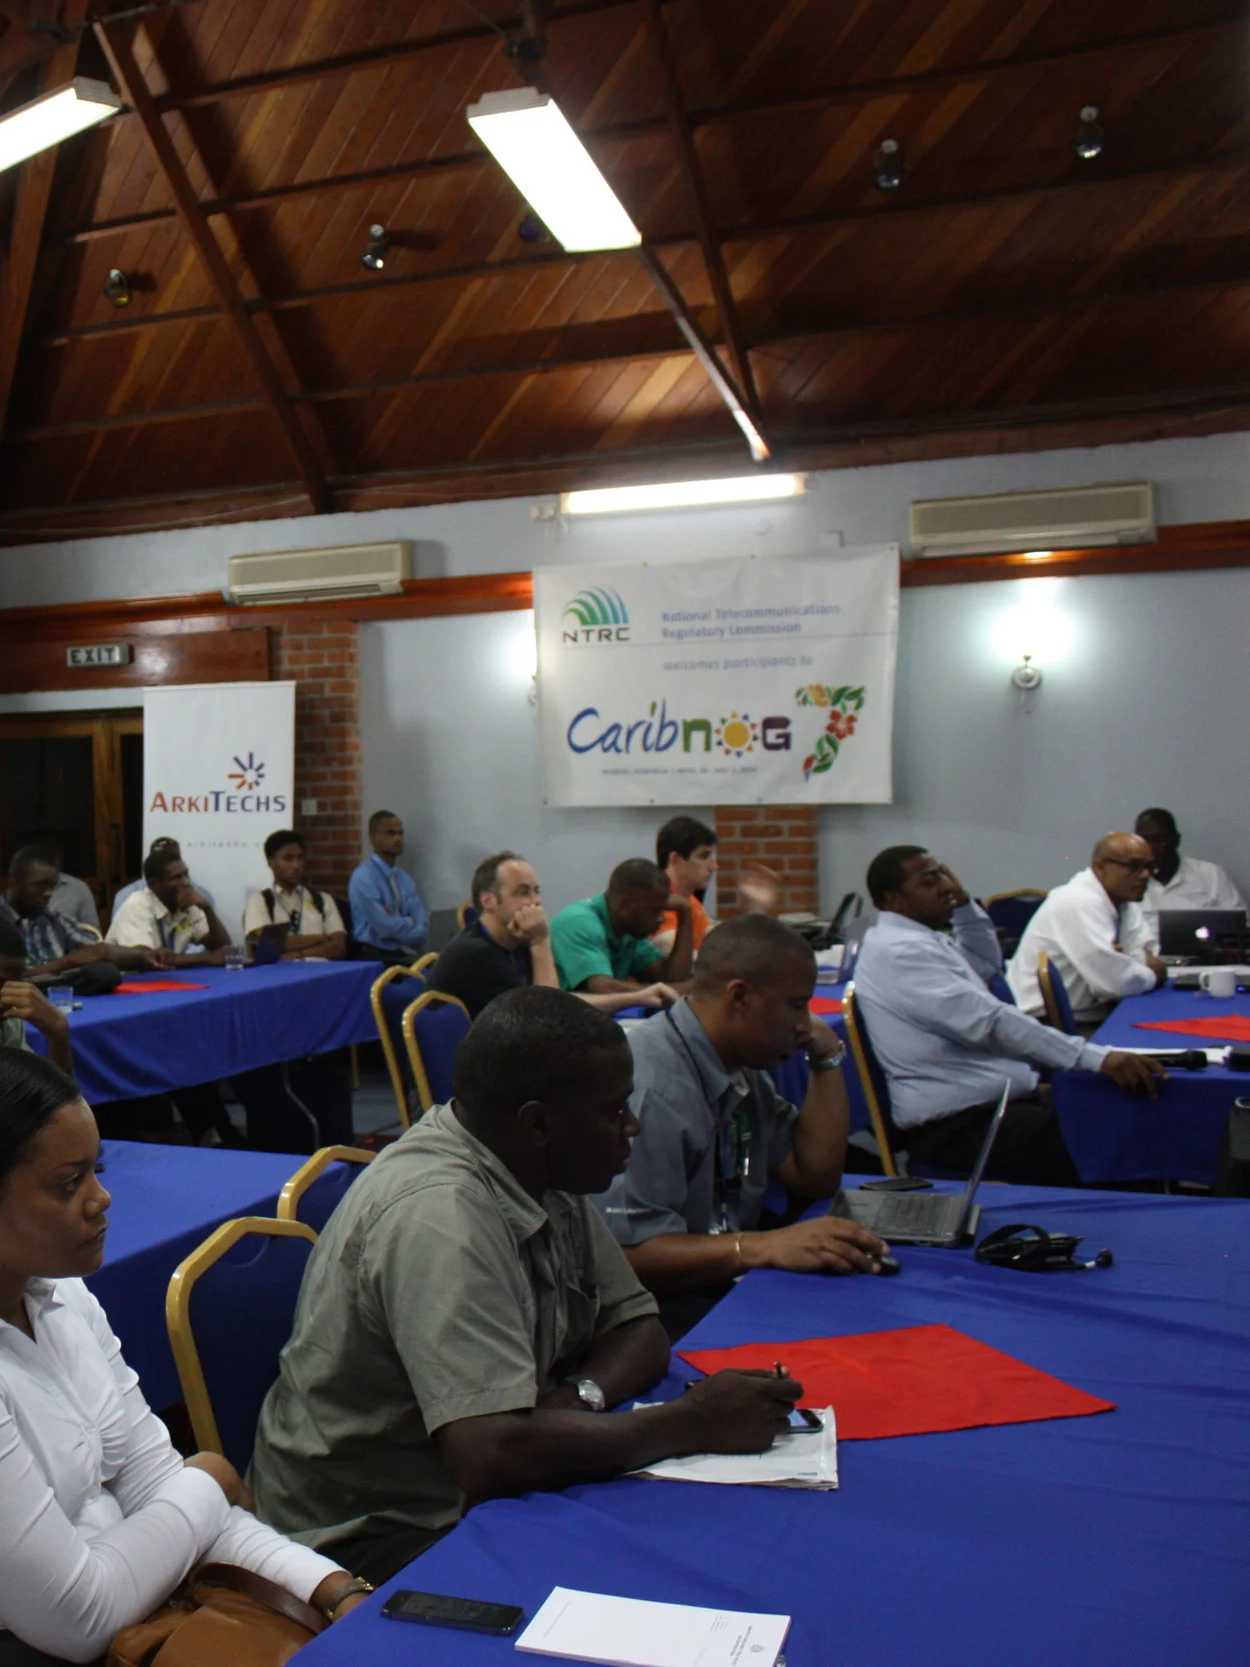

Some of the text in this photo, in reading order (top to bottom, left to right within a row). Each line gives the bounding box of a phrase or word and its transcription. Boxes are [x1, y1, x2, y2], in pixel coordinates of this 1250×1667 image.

[661, 604, 841, 622] National Telecommunications
[563, 627, 630, 643] NTRC
[661, 622, 802, 640] Regulatory Commission
[71, 647, 114, 664] EXIT
